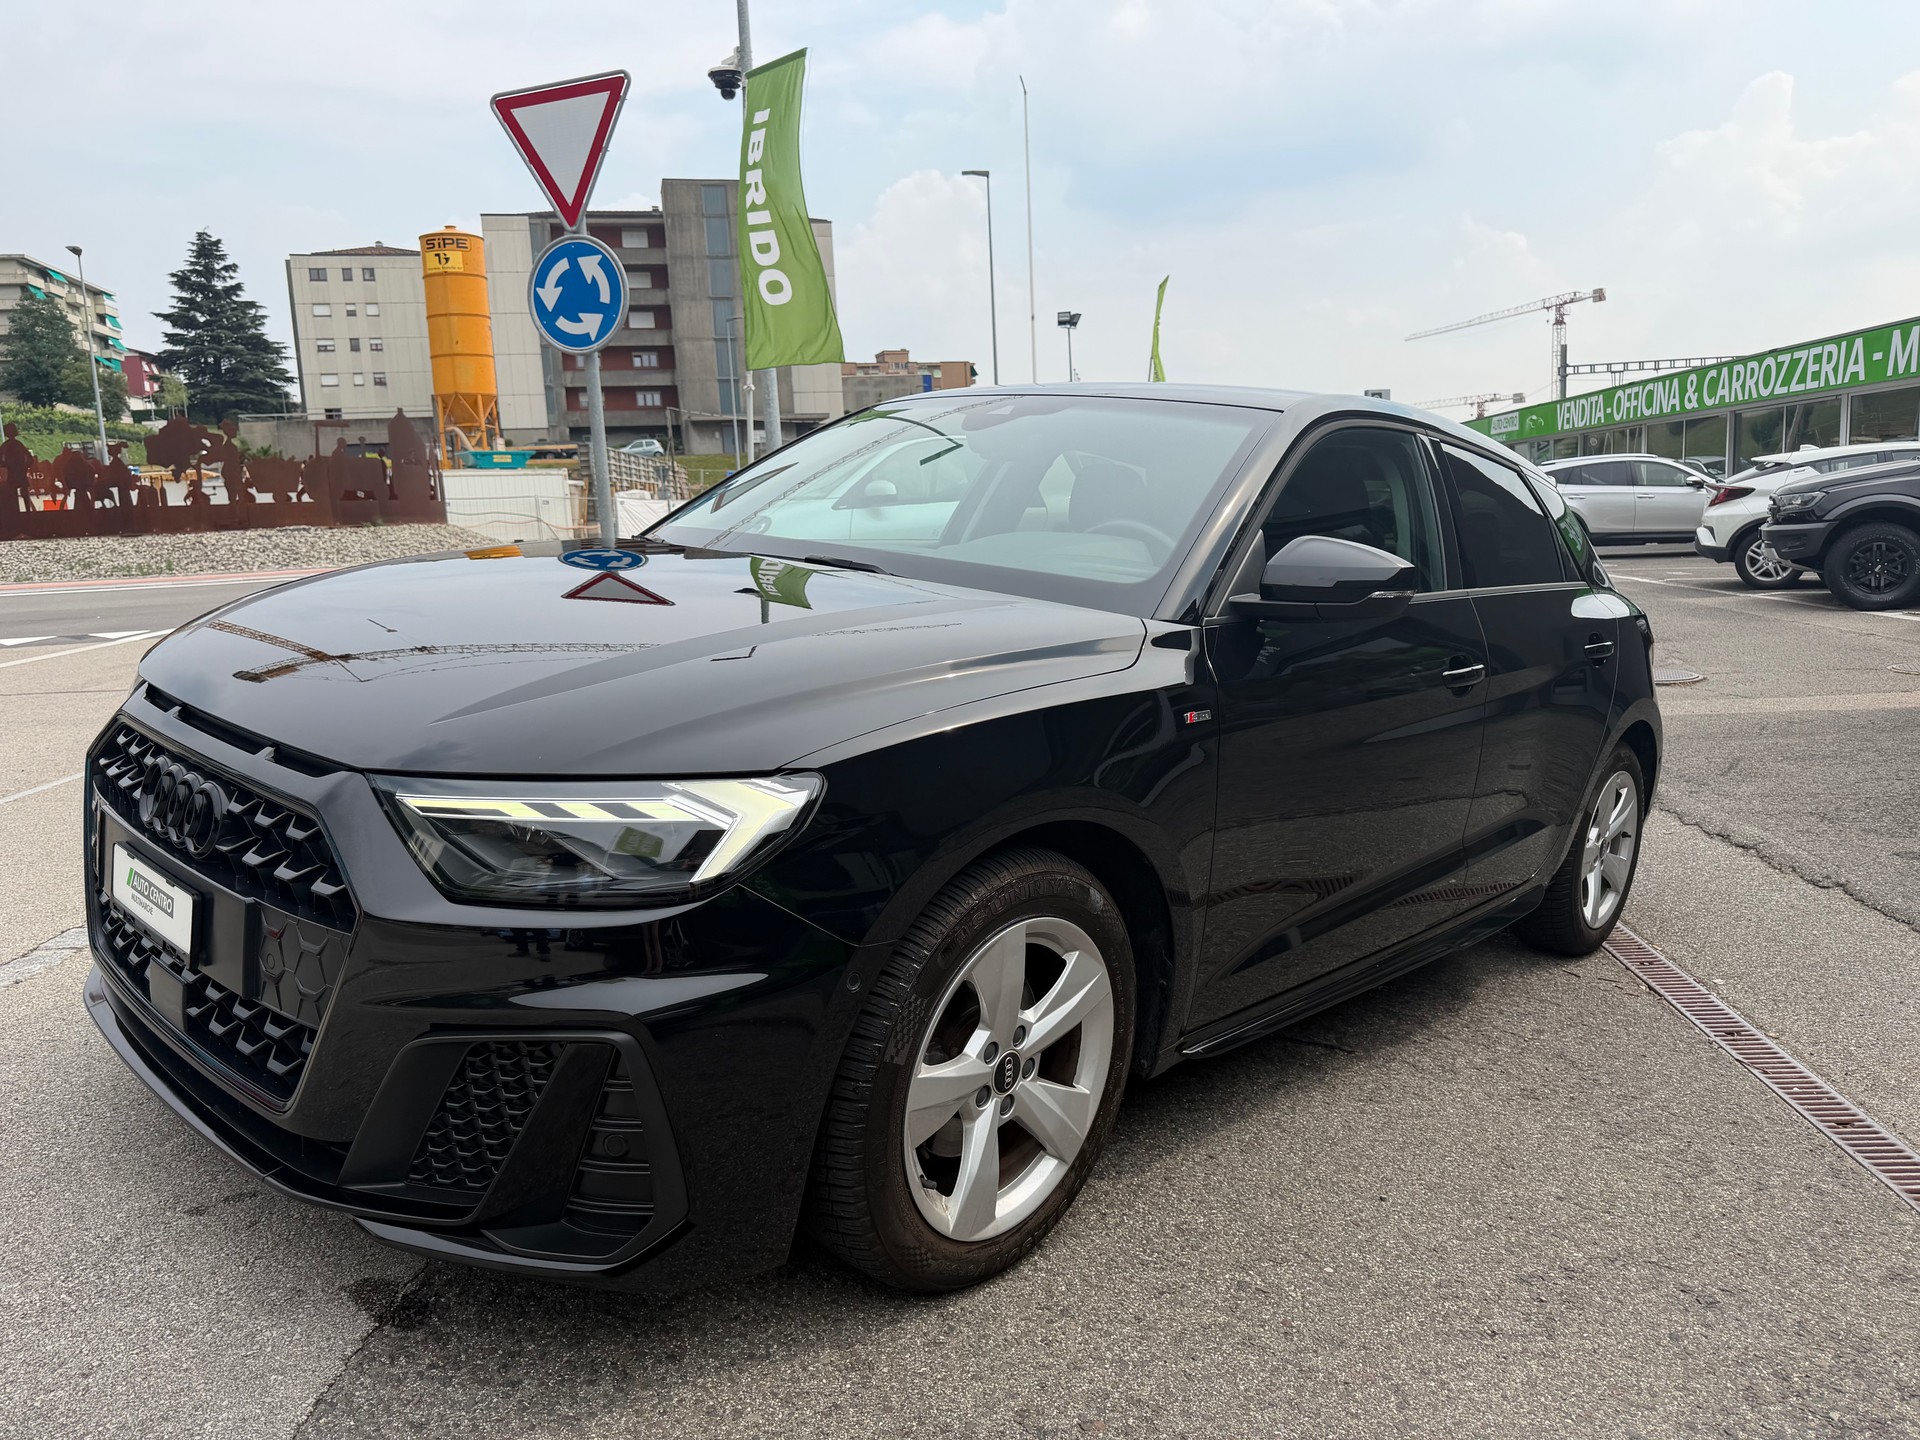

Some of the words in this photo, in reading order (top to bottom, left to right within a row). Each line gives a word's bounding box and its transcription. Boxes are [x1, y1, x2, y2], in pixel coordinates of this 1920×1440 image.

[745, 107, 793, 306] IBRIDO
[1557, 394, 1605, 431] VENDITA
[1613, 378, 1680, 422] OFFICINA
[1684, 373, 1699, 410] &
[1702, 337, 1865, 407] CARROZZERIA
[1886, 325, 1920, 377] M
[132, 874, 150, 896] AUTO
[149, 886, 173, 913] CENTRO
